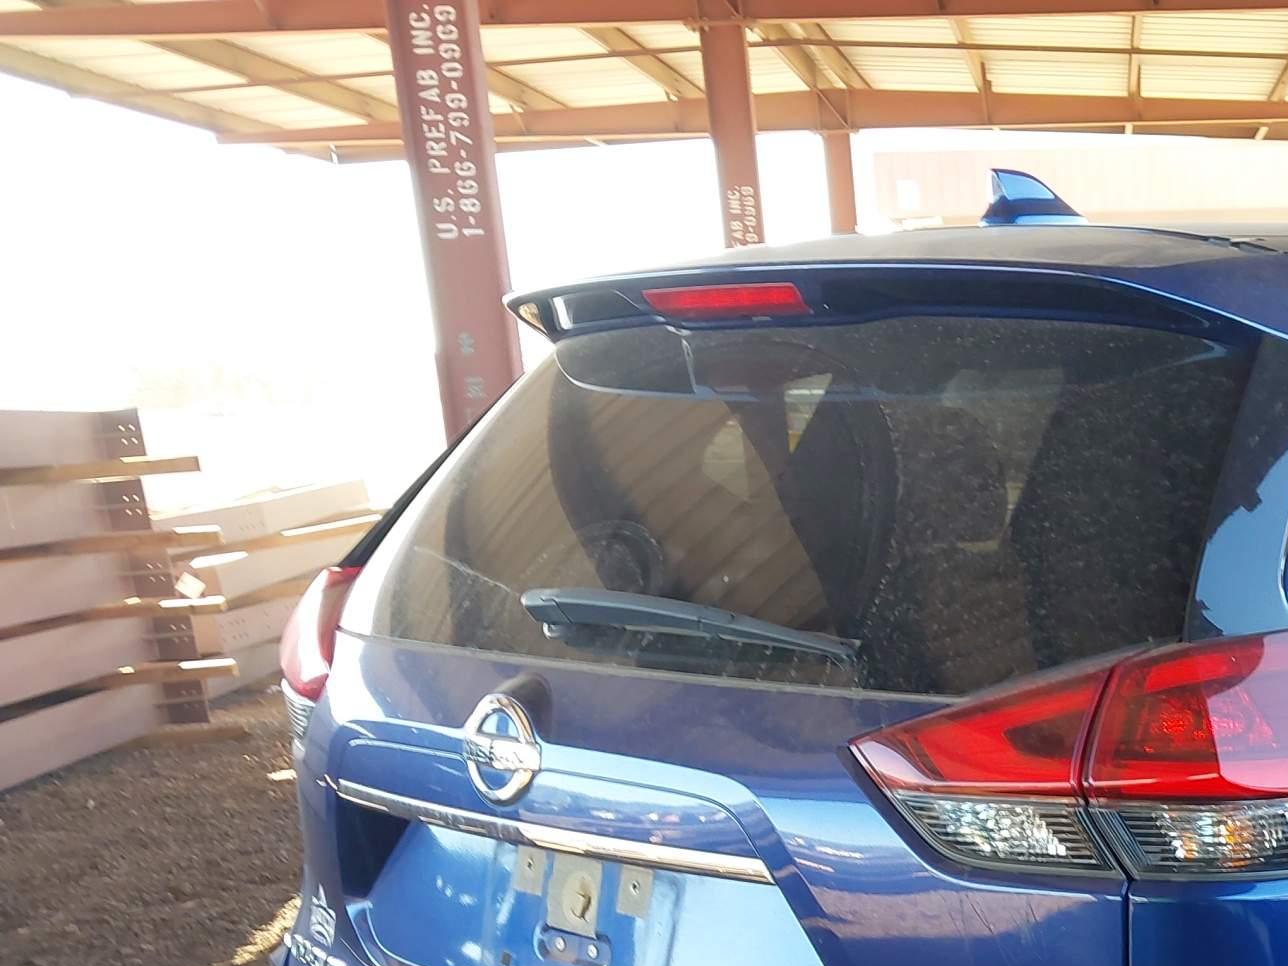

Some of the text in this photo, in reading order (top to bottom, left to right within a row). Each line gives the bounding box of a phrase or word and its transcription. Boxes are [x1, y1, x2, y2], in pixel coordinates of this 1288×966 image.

[408, 3, 459, 240] U.S. PREFAB INC.
[433, 4, 485, 237] 1-866-799-0969
